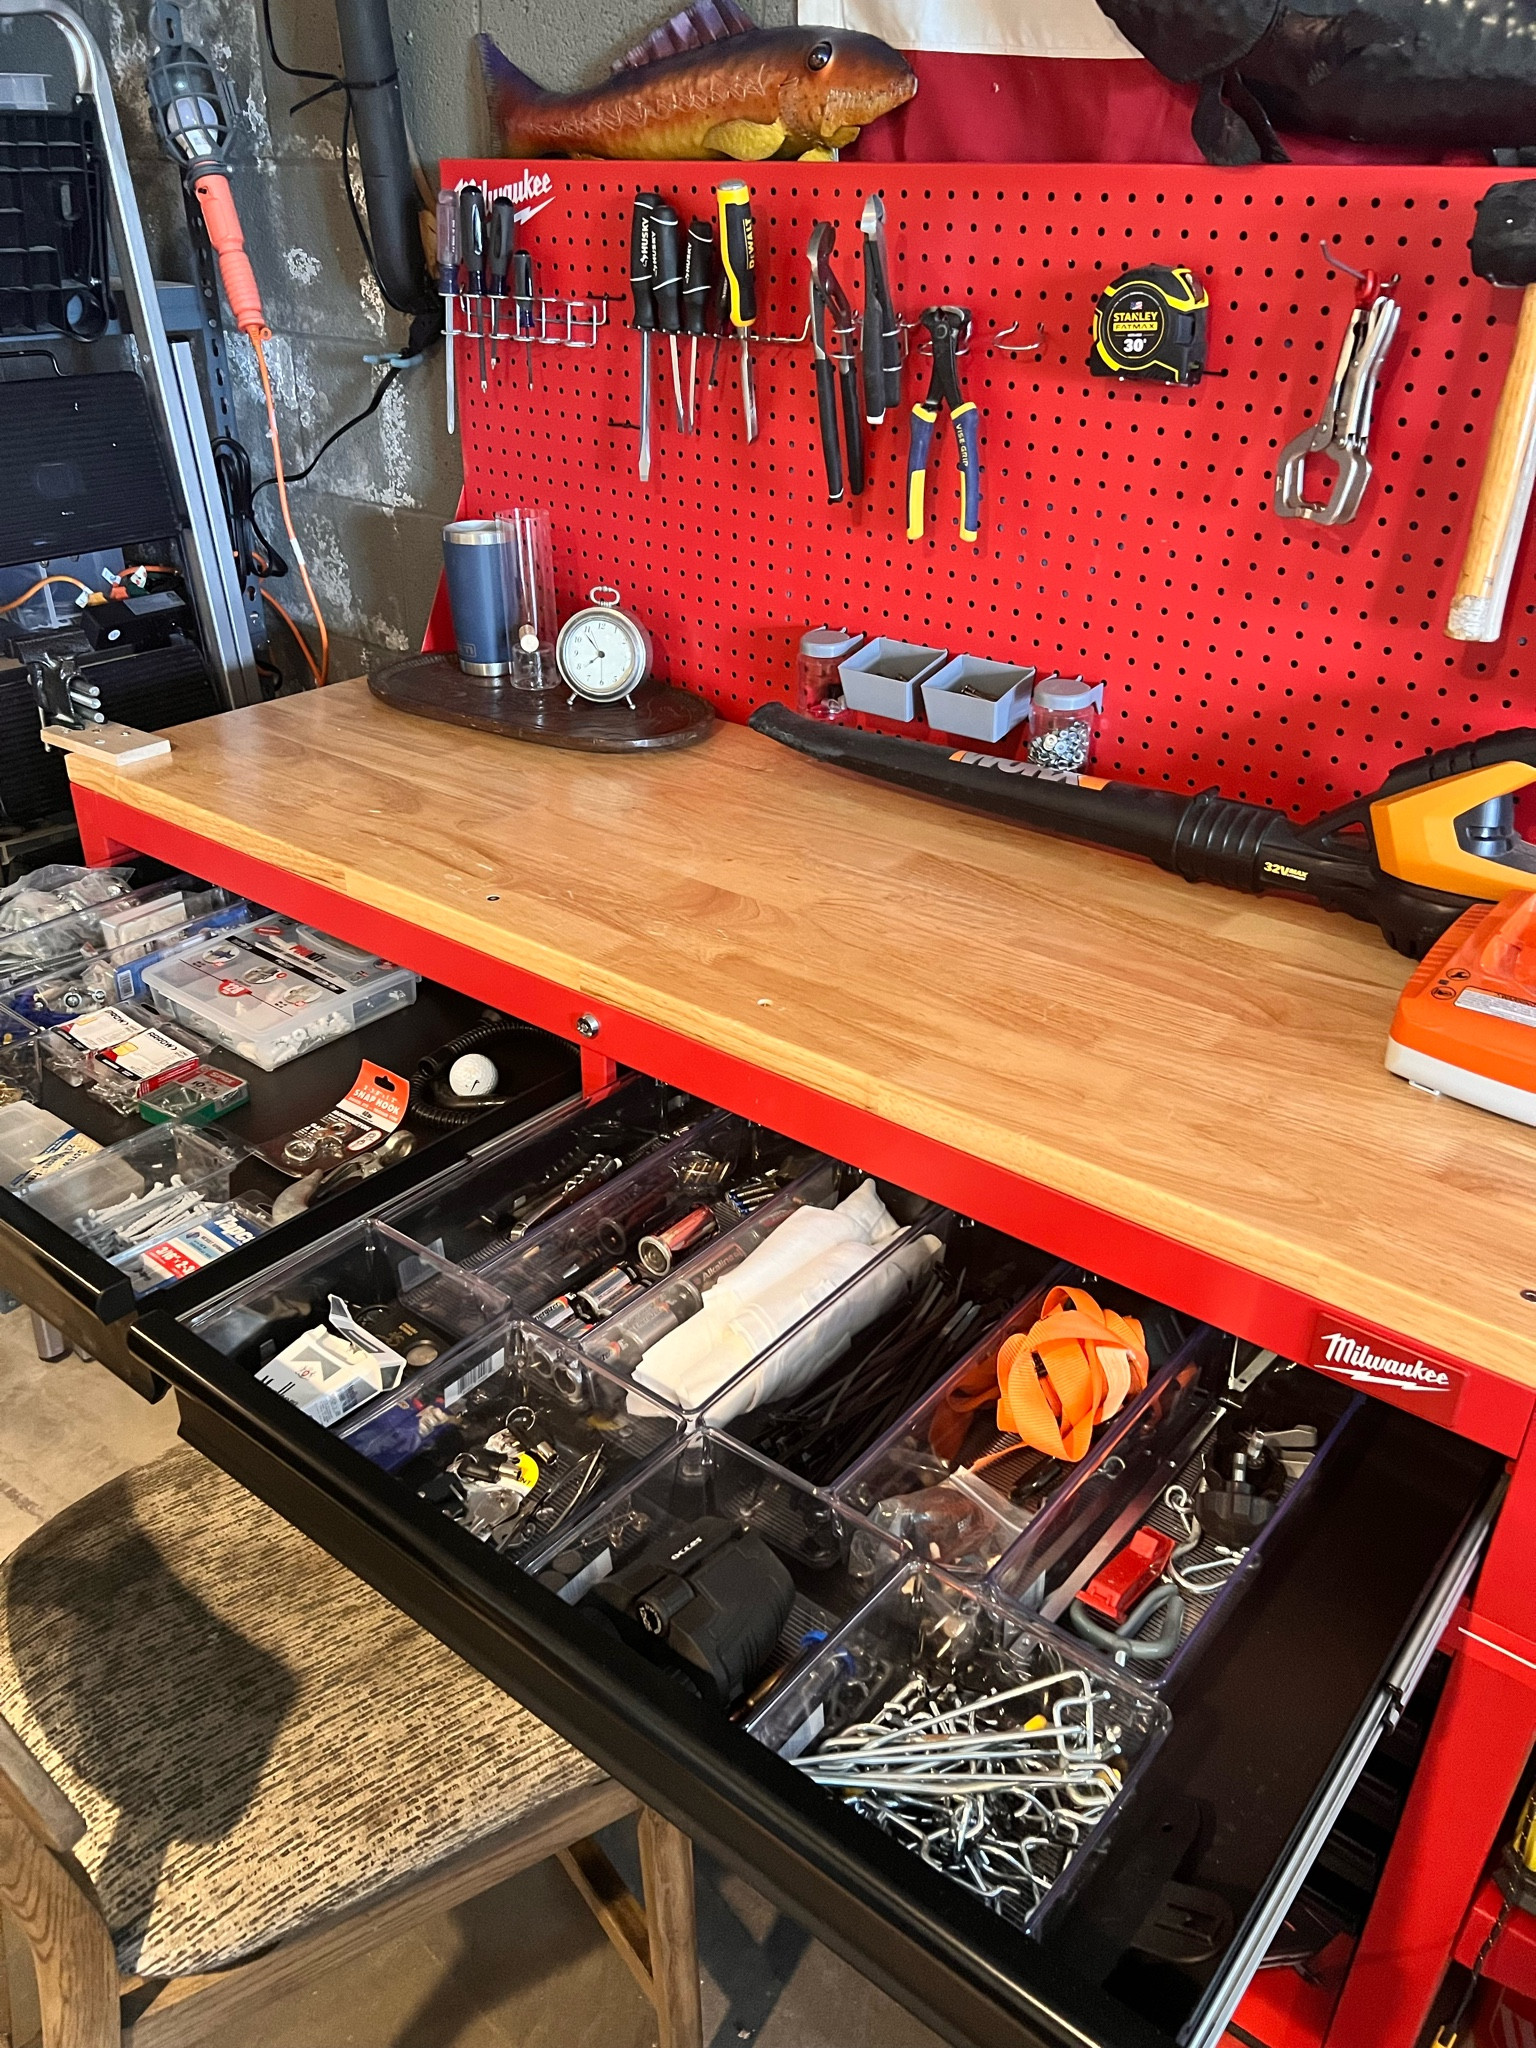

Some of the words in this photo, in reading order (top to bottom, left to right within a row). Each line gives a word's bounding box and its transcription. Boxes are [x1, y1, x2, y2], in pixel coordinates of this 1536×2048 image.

[641, 217, 649, 254] HUSKY
[1113, 312, 1158, 321] STANLEY
[353, 1089, 376, 1103] SNAP
[375, 1098, 401, 1115] HOOK
[534, 1302, 560, 1321] nergizer
[1321, 1333, 1449, 1385] Milwaukee
